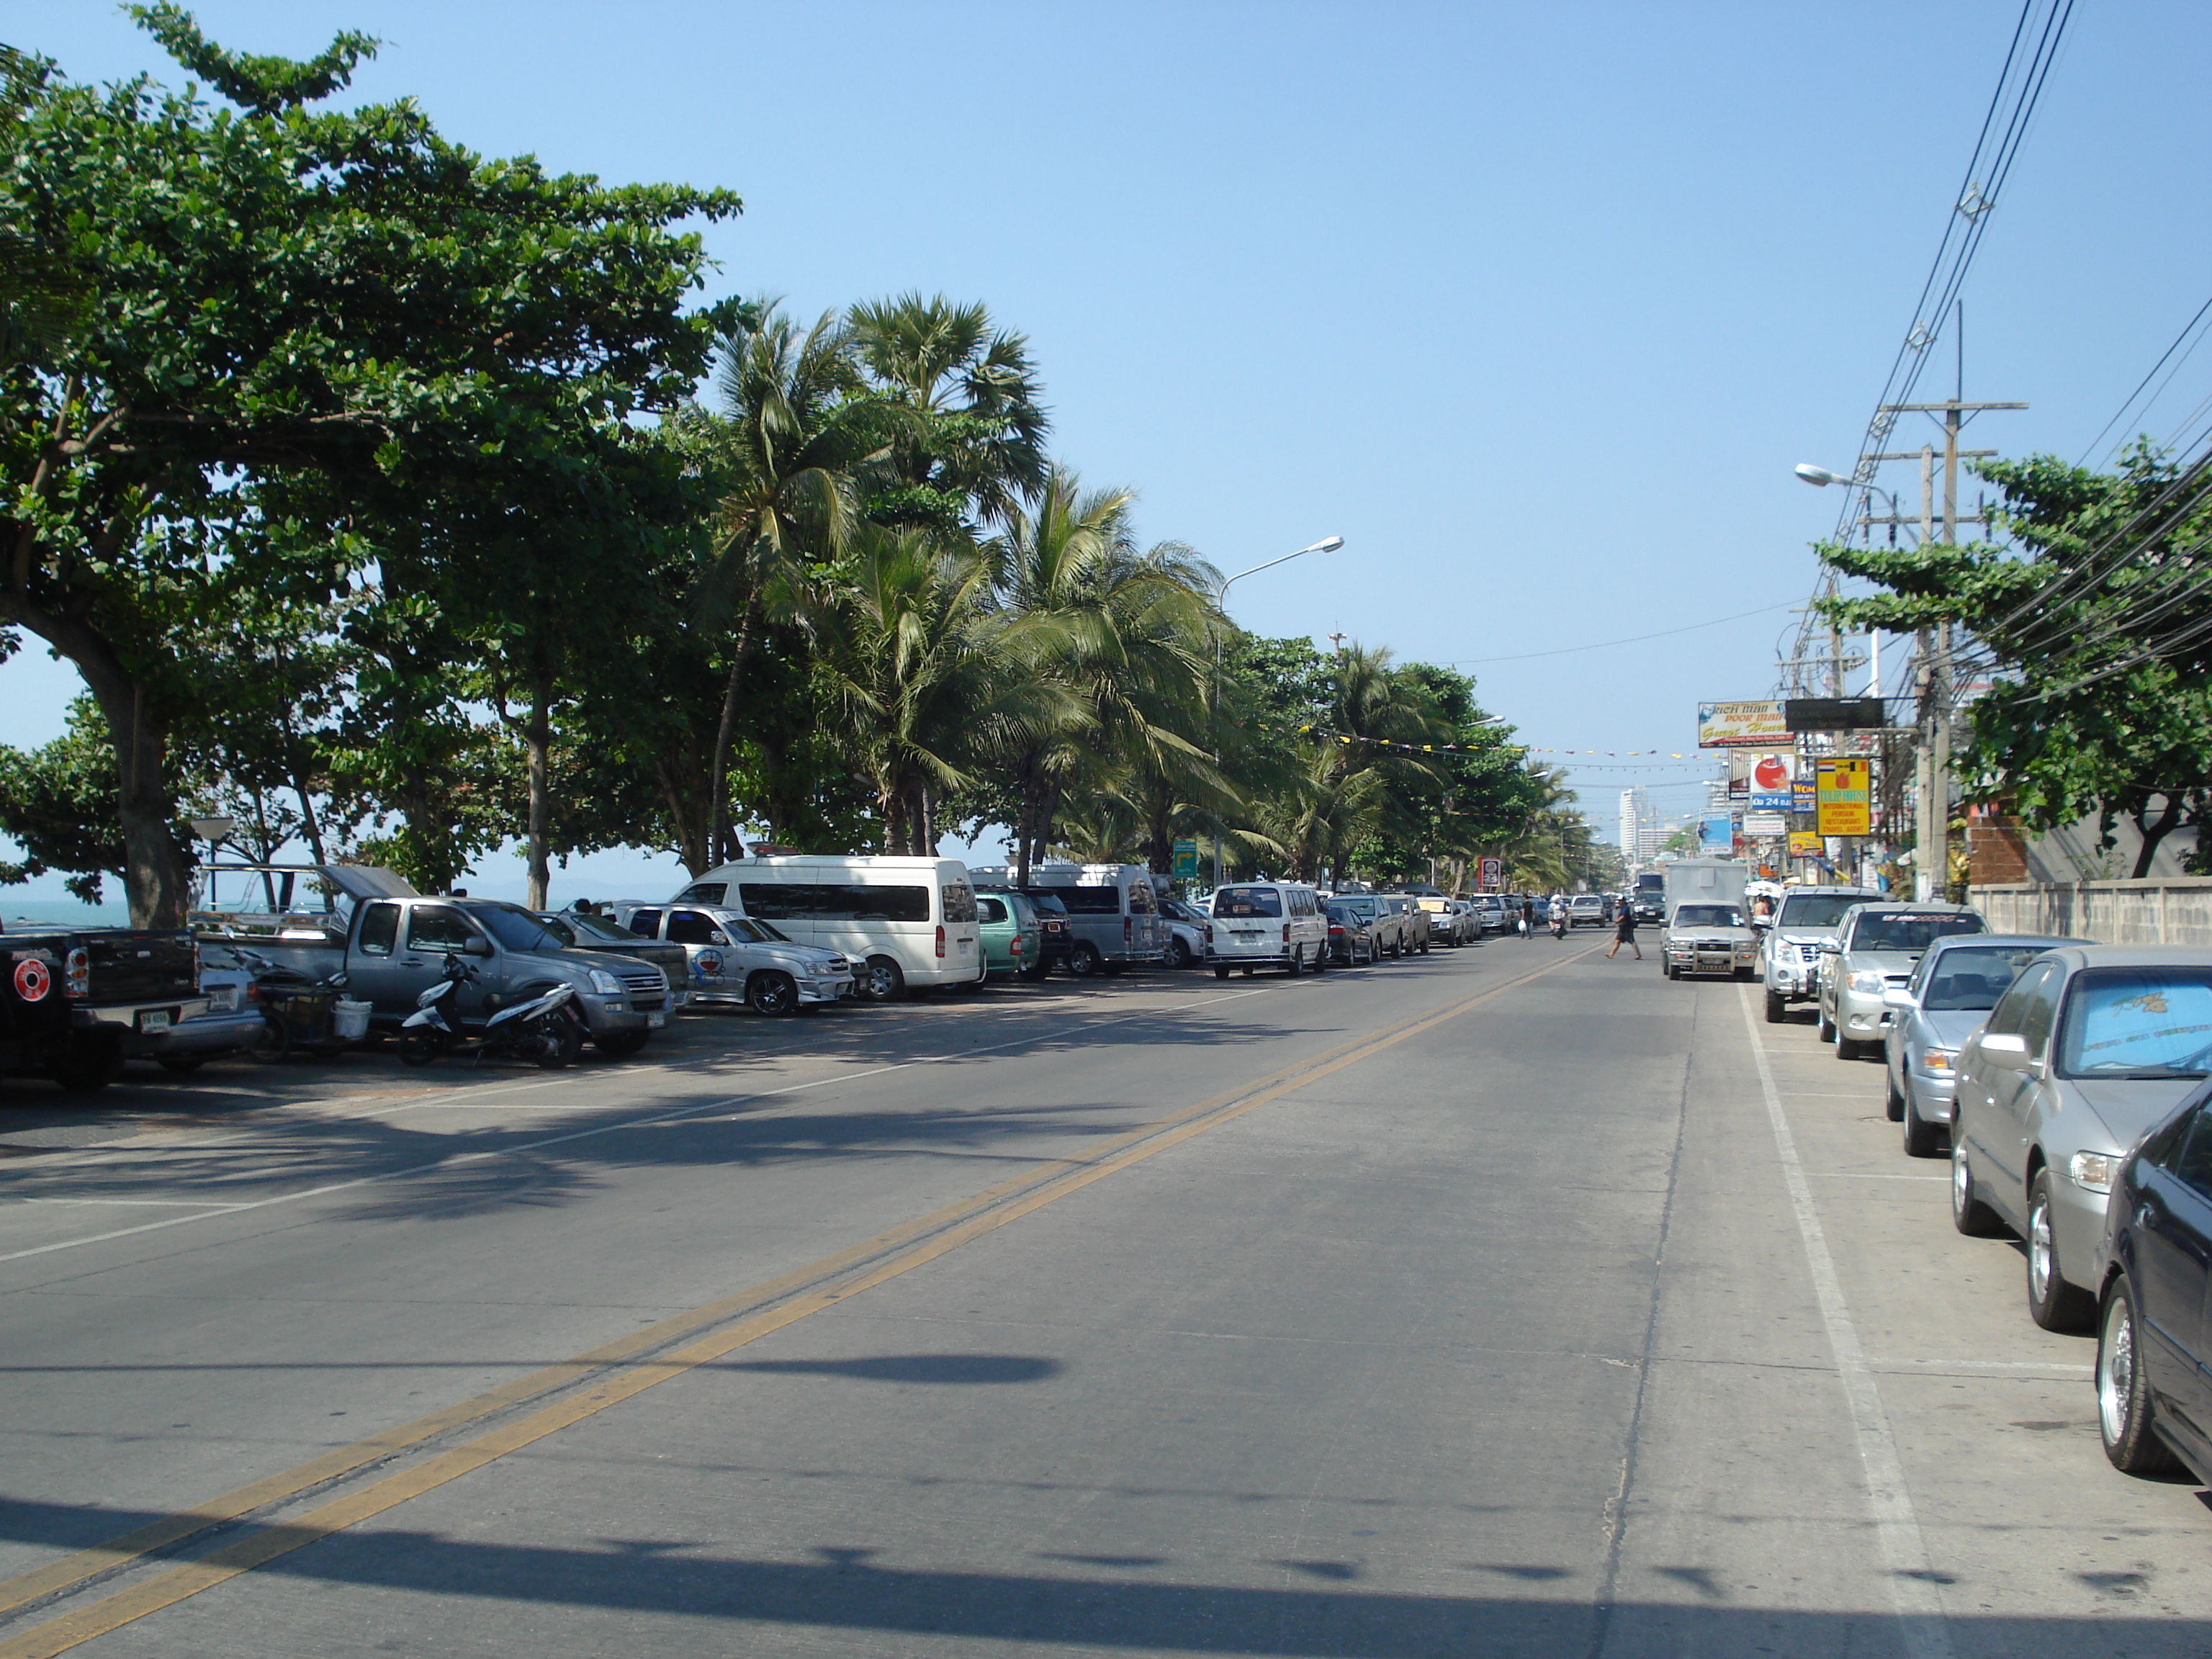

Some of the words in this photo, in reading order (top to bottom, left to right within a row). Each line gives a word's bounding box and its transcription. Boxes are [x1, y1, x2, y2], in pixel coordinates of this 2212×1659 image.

[1713, 705, 1739, 714] RICH
[1743, 705, 1768, 714] MAN
[1725, 714, 1753, 722] POOR
[1757, 713, 1783, 721] MAN
[1819, 790, 1842, 802] TULIP
[1843, 790, 1867, 802] HOUSE
[1766, 797, 1779, 806] 24
